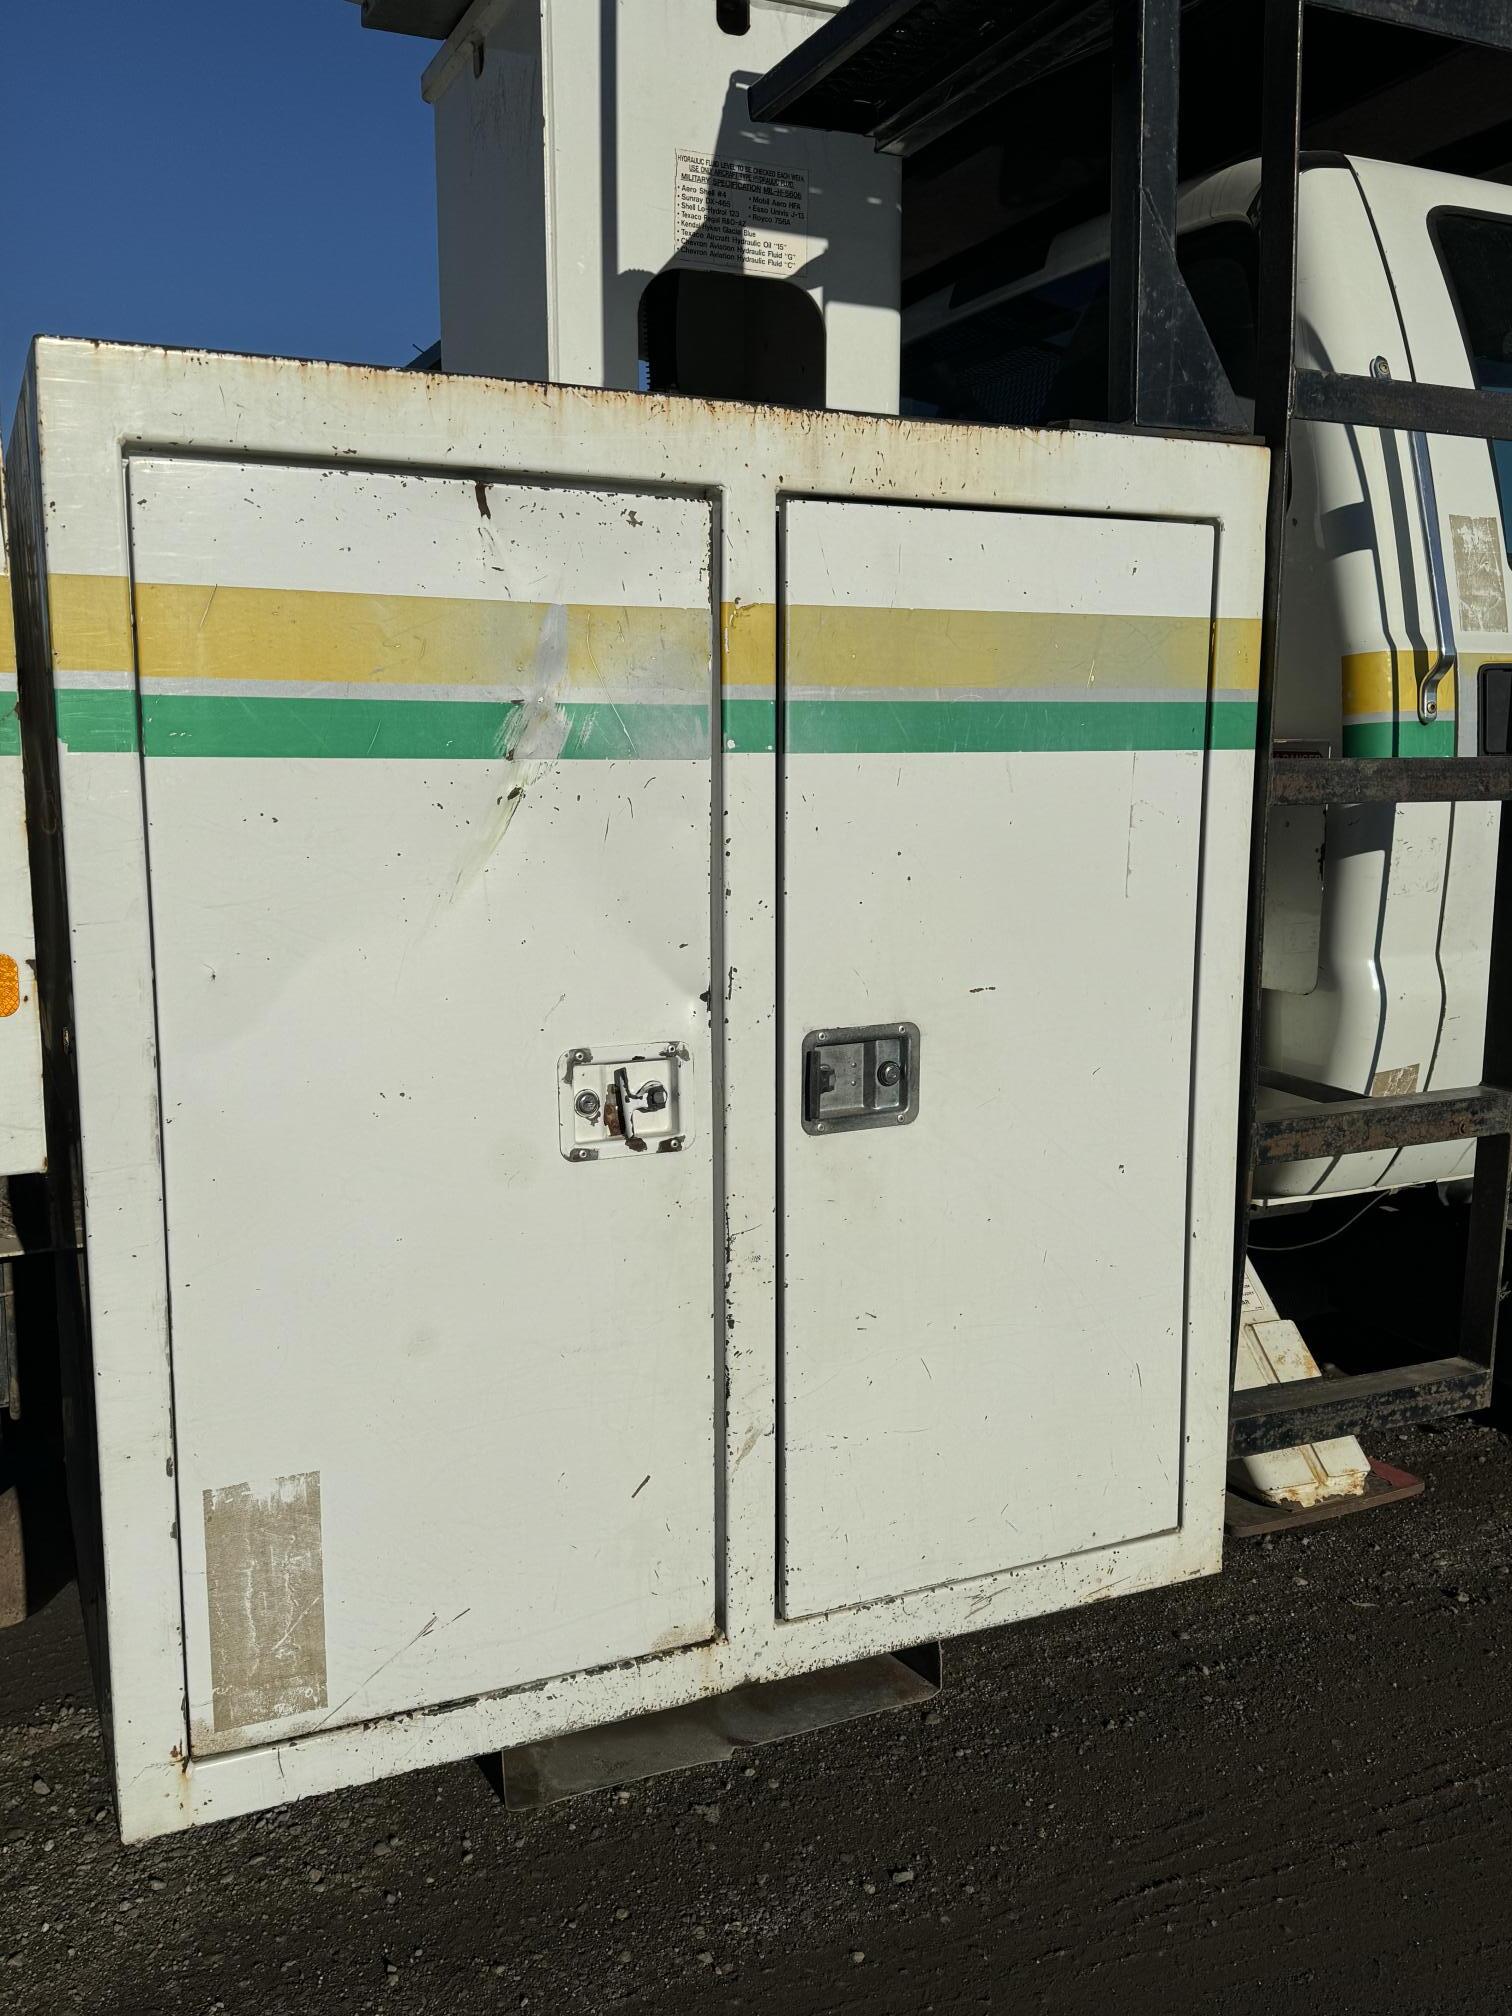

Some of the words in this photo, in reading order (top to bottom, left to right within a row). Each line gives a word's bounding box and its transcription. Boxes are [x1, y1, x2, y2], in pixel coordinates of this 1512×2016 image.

[678, 155, 705, 165] HYDRAULIC
[706, 160, 719, 168] FLUID
[721, 162, 735, 170] LEVEL
[753, 168, 776, 177] CHECKED
[689, 165, 700, 173] USE
[700, 167, 713, 175] ONLY
[681, 173, 711, 184] MILITARY
[713, 178, 761, 193] SPECIFICATION
[682, 185, 697, 193] Aero
[700, 188, 714, 197] Shell
[682, 193, 703, 204] Sunray
[753, 197, 769, 205] Mobil
[772, 200, 787, 208] Aero
[682, 202, 695, 210] Shell
[753, 205, 768, 213] Esso
[682, 211, 702, 220] Texaco
[753, 213, 772, 224] Royco
[682, 229, 704, 238] Texaco
[707, 233, 730, 243] Aircraft
[733, 237, 761, 247] Hydraulic
[763, 241, 772, 249] Oil
[681, 238, 707, 248] Chevron
[710, 242, 734, 252] Aviation
[738, 246, 765, 257] Hydraulic
[768, 250, 783, 259] Fluid
[681, 246, 707, 256] Chevron
[710, 250, 734, 260] Aviation
[737, 254, 765, 265] Hydraulic
[768, 259, 783, 267] Fluid
